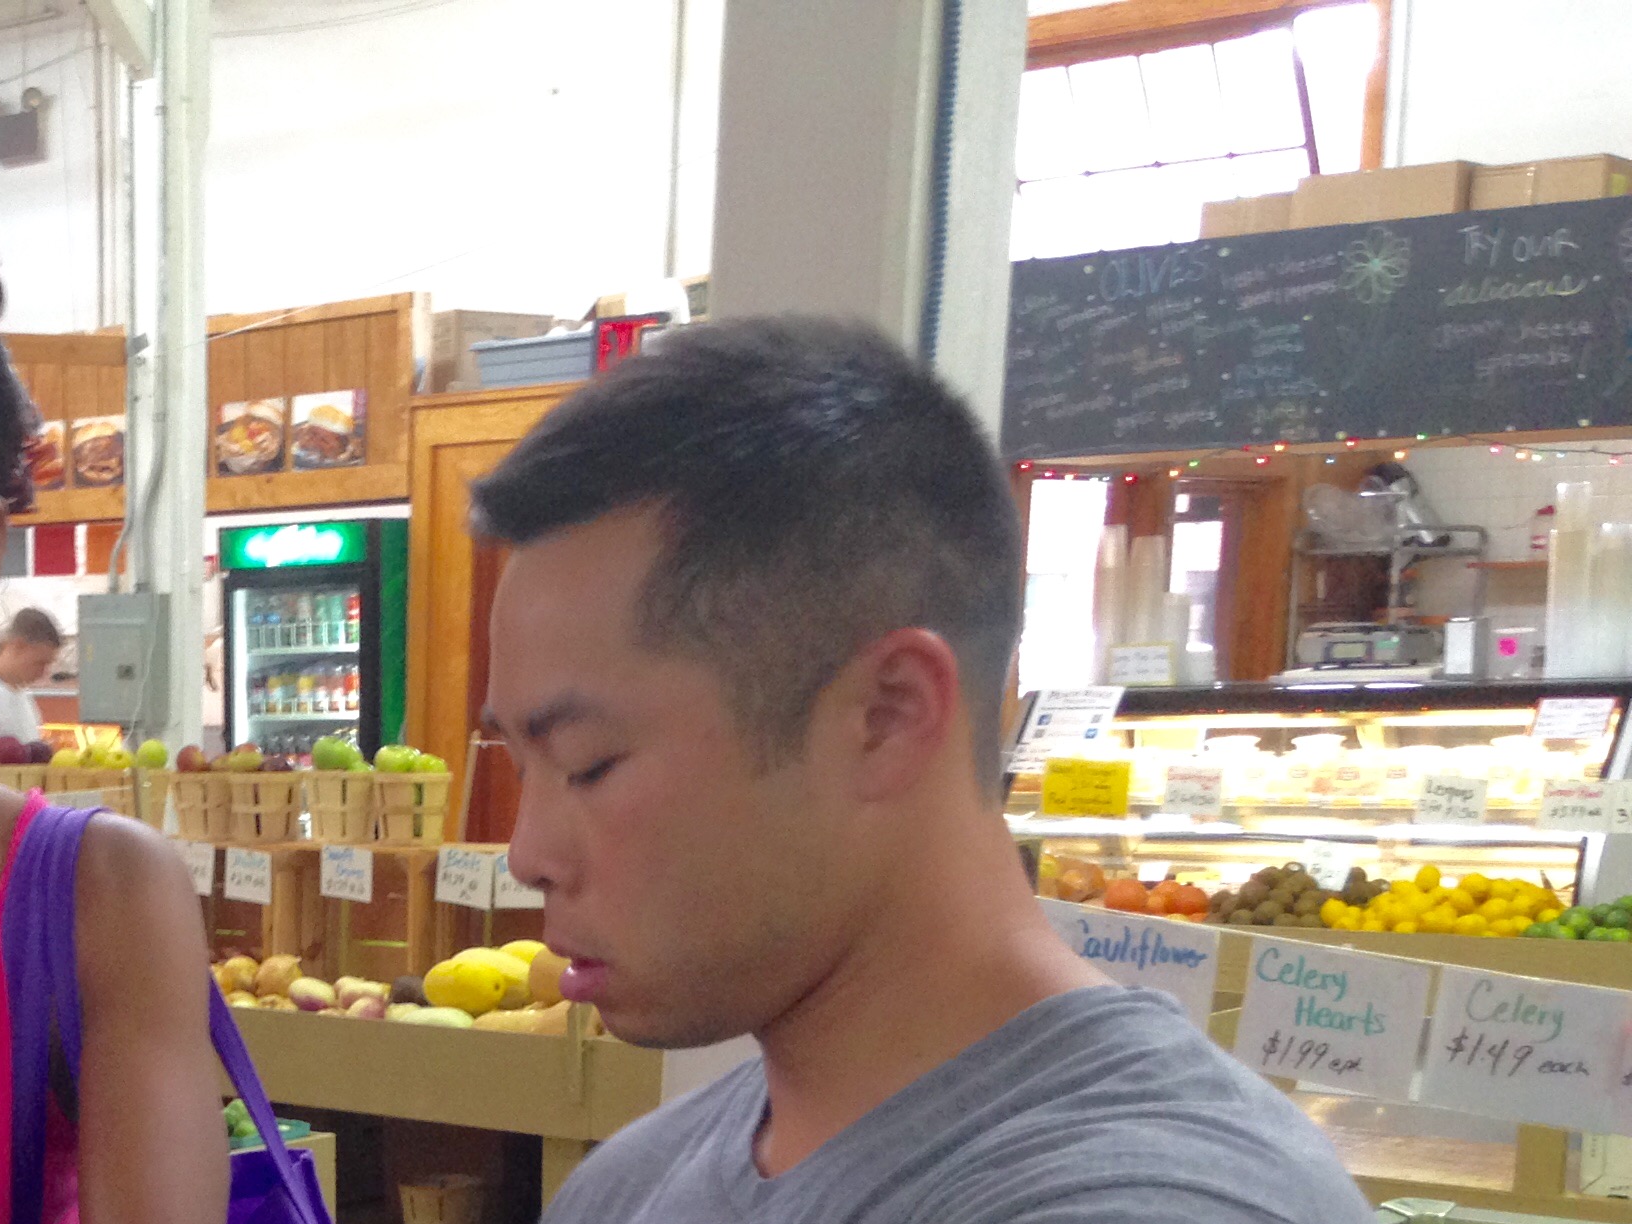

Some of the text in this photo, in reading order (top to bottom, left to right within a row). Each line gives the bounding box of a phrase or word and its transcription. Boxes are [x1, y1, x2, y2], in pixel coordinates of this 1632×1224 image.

[1099, 246, 1209, 302] OLIVES
[1255, 947, 1348, 1001] Celery
[1295, 996, 1387, 1036] Hearts
[1468, 979, 1564, 1044] Celery
